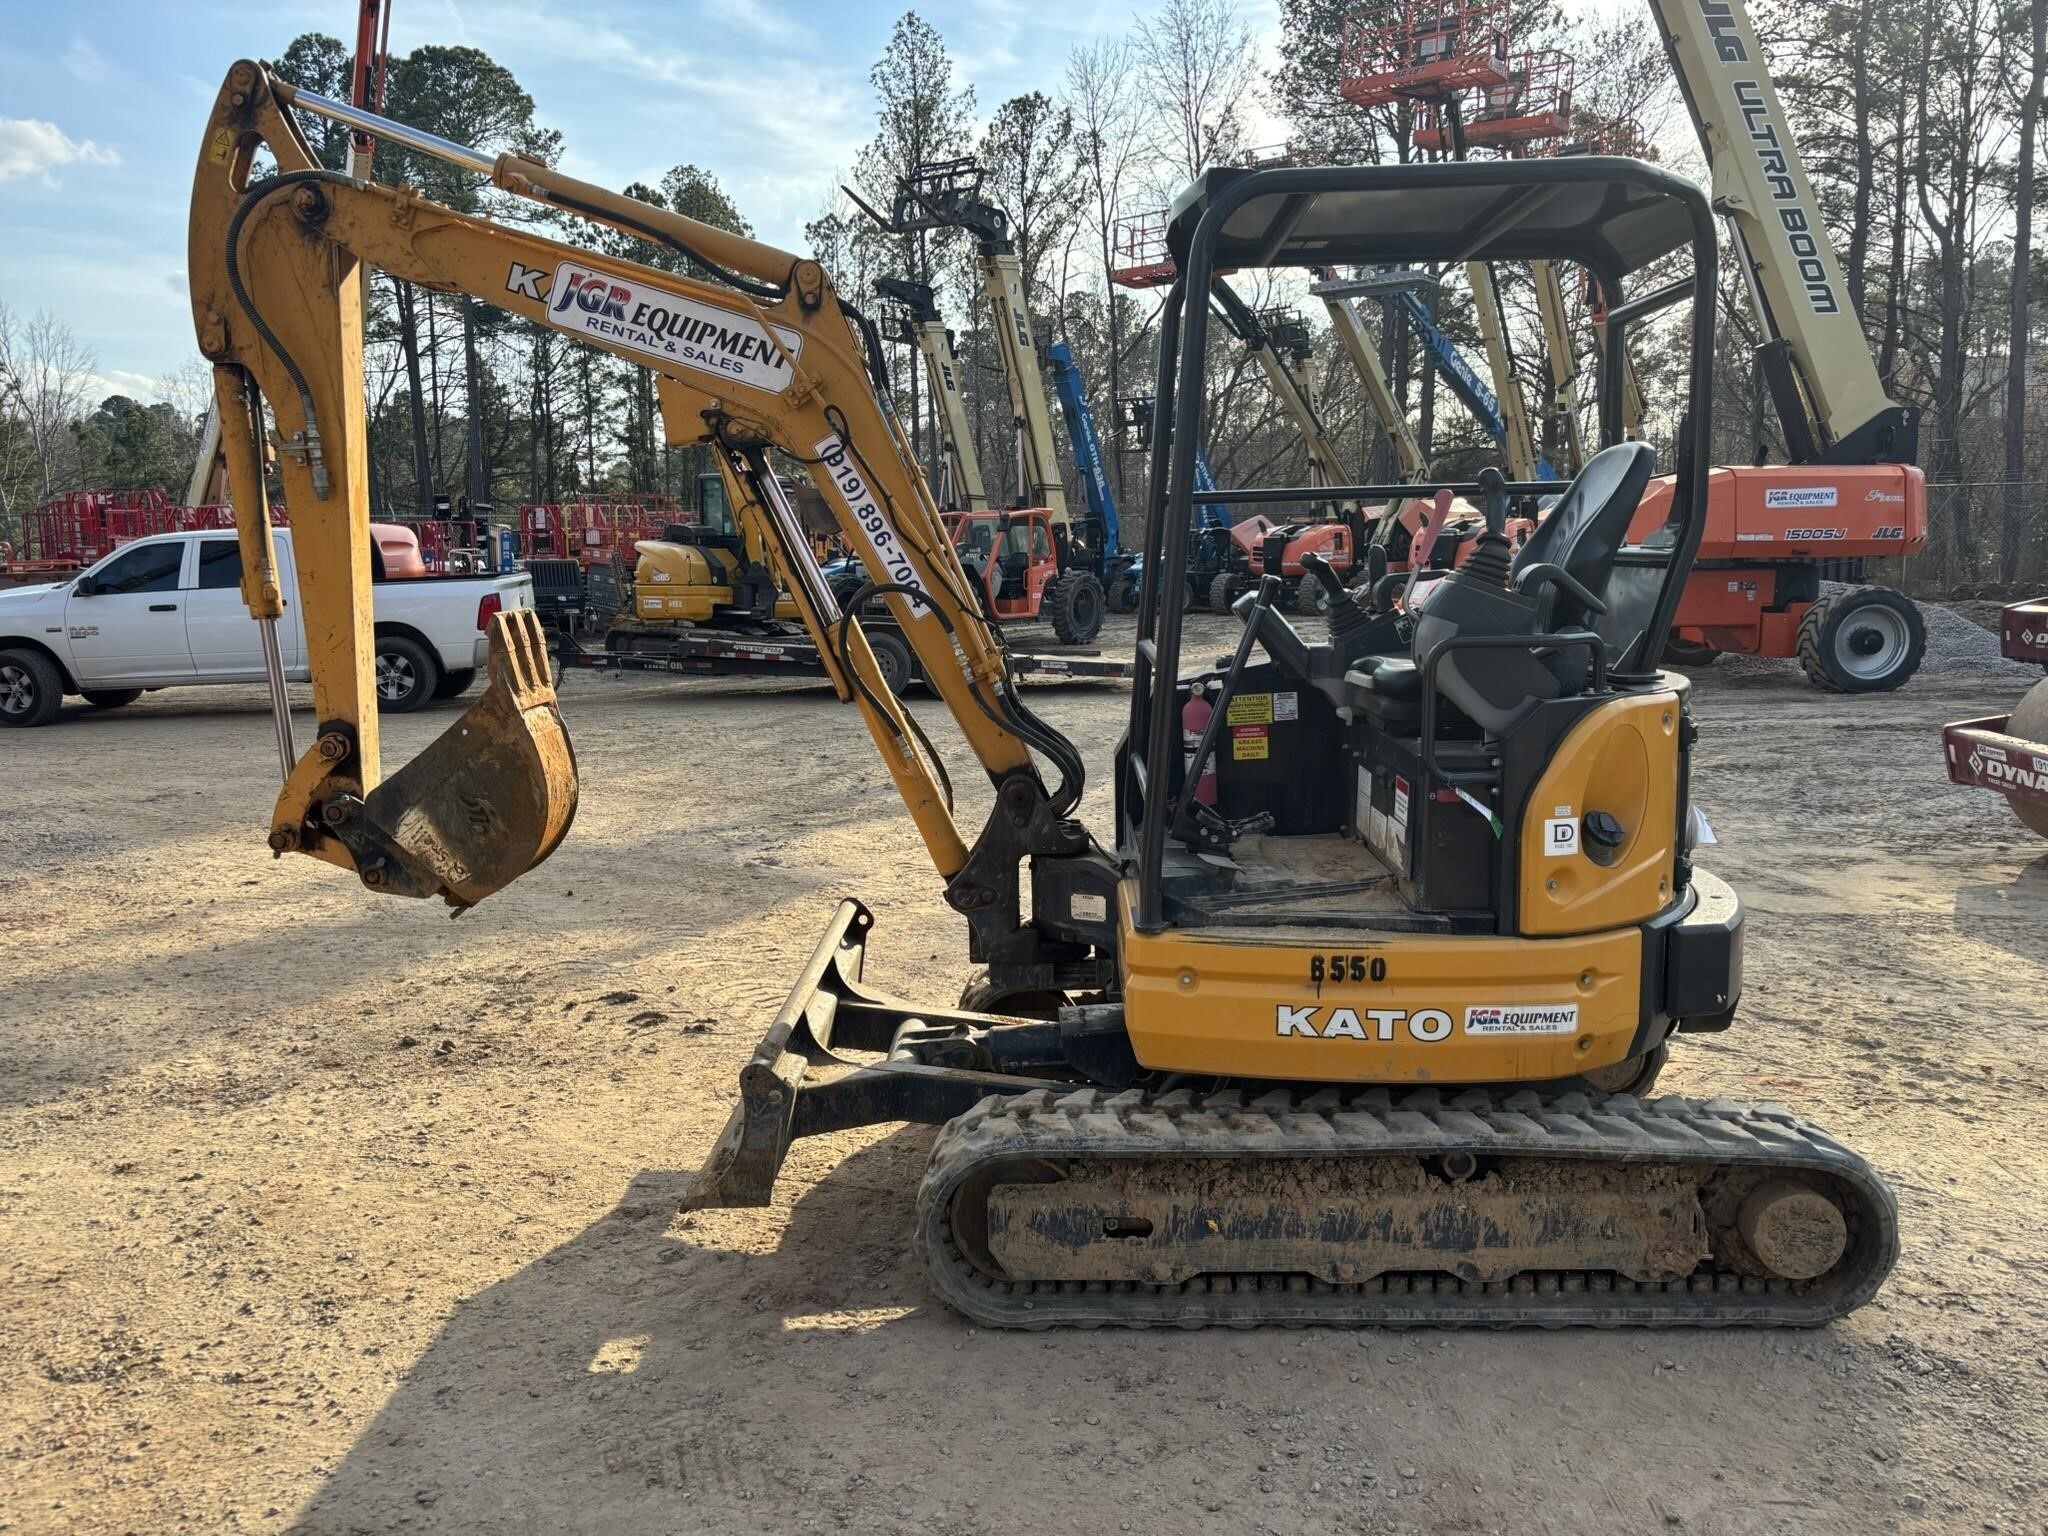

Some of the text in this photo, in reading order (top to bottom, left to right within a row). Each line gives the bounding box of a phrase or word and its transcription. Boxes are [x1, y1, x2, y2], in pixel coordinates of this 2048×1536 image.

[1732, 80, 1798, 201] ULTRA
[1777, 207, 1841, 315] BOOM
[553, 271, 796, 370] JGR EQUIPMENT
[586, 316, 744, 374] RENTAL & SALES
[941, 361, 956, 392] JLG
[1789, 491, 1836, 501] EQUIPMENT
[1784, 528, 1848, 541] 1500SJ
[1871, 526, 1905, 540] JLG
[1276, 1004, 1454, 1042] KATO
[1466, 1009, 1576, 1029] JGR EQUIPMENT
